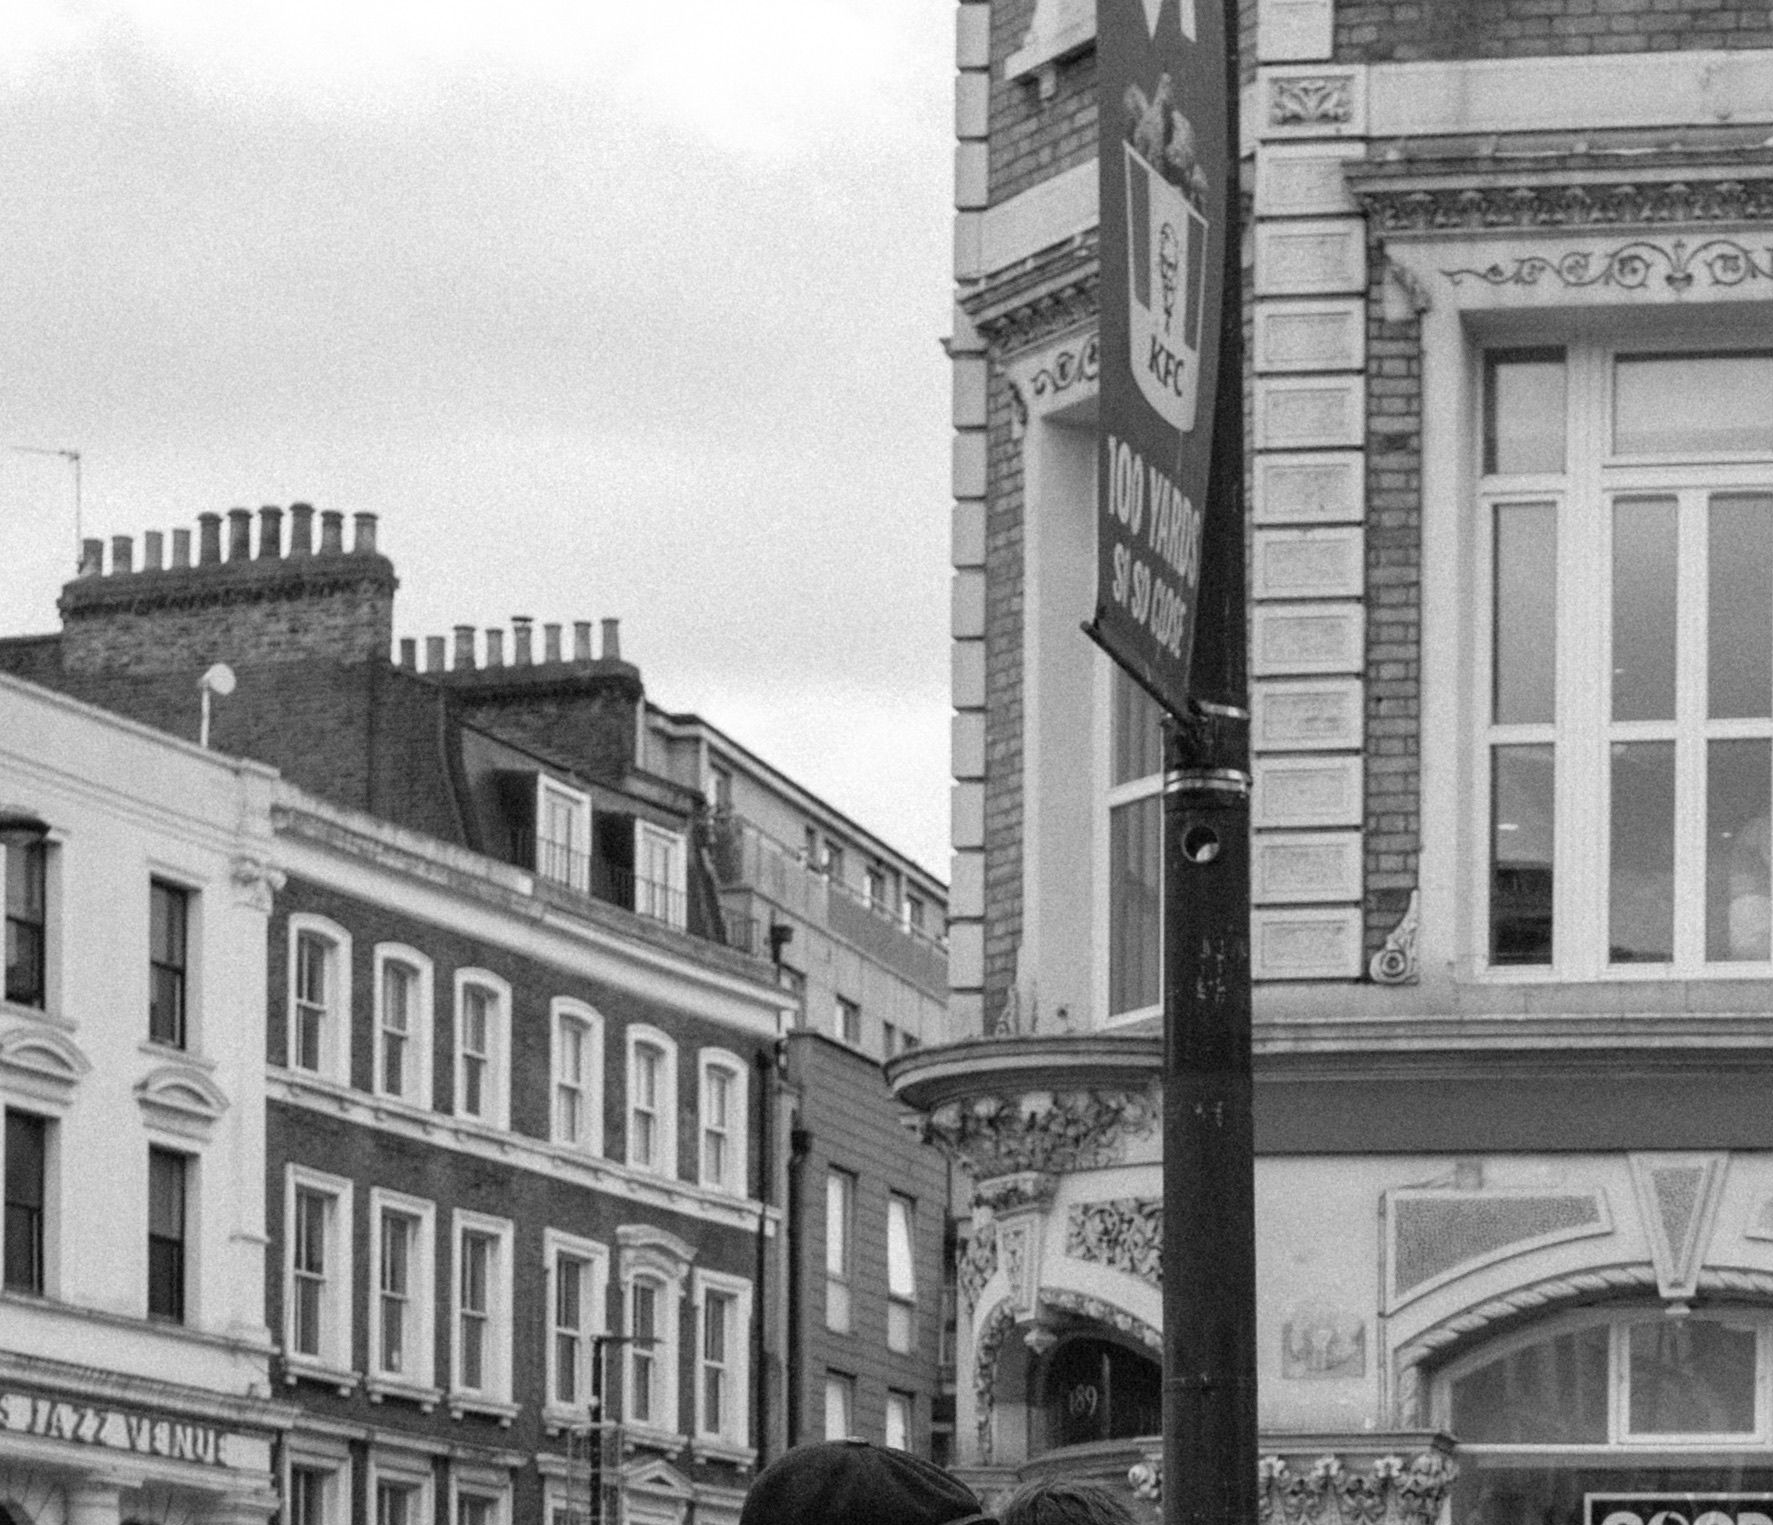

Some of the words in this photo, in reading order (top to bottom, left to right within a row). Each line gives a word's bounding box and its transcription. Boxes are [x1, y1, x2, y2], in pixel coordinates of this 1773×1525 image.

[1148, 335, 1184, 397] KFC
[1108, 434, 1144, 536] 100
[1149, 466, 1201, 588] YARDS
[26, 1398, 106, 1447] JAZZ
[125, 1411, 229, 1469] VENUE
